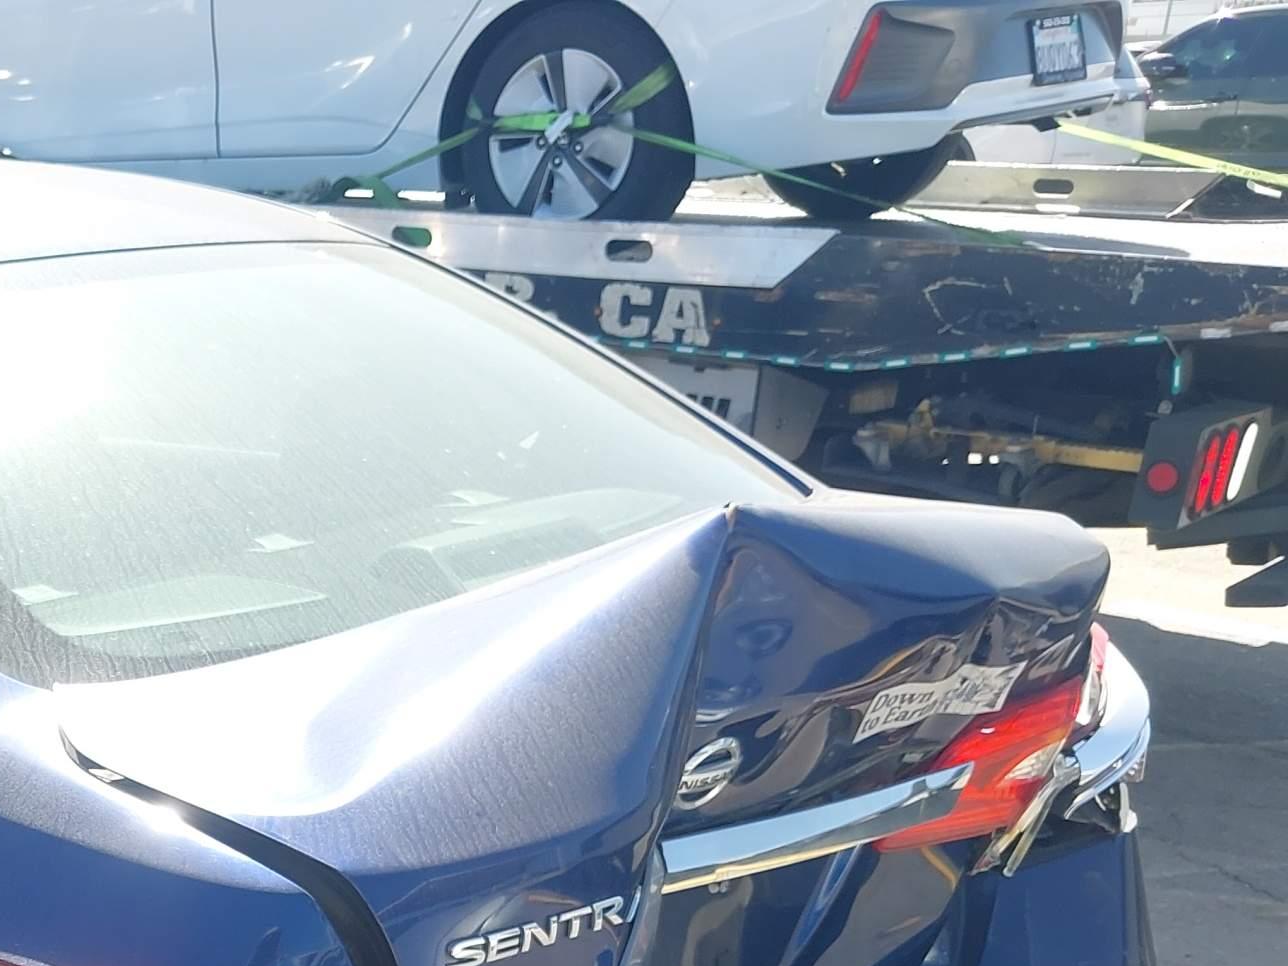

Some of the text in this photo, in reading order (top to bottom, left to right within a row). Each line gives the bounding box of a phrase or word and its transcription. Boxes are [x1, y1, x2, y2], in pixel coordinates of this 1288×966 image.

[599, 283, 710, 347] CA
[871, 690, 935, 714] Down
[861, 716, 880, 734] to
